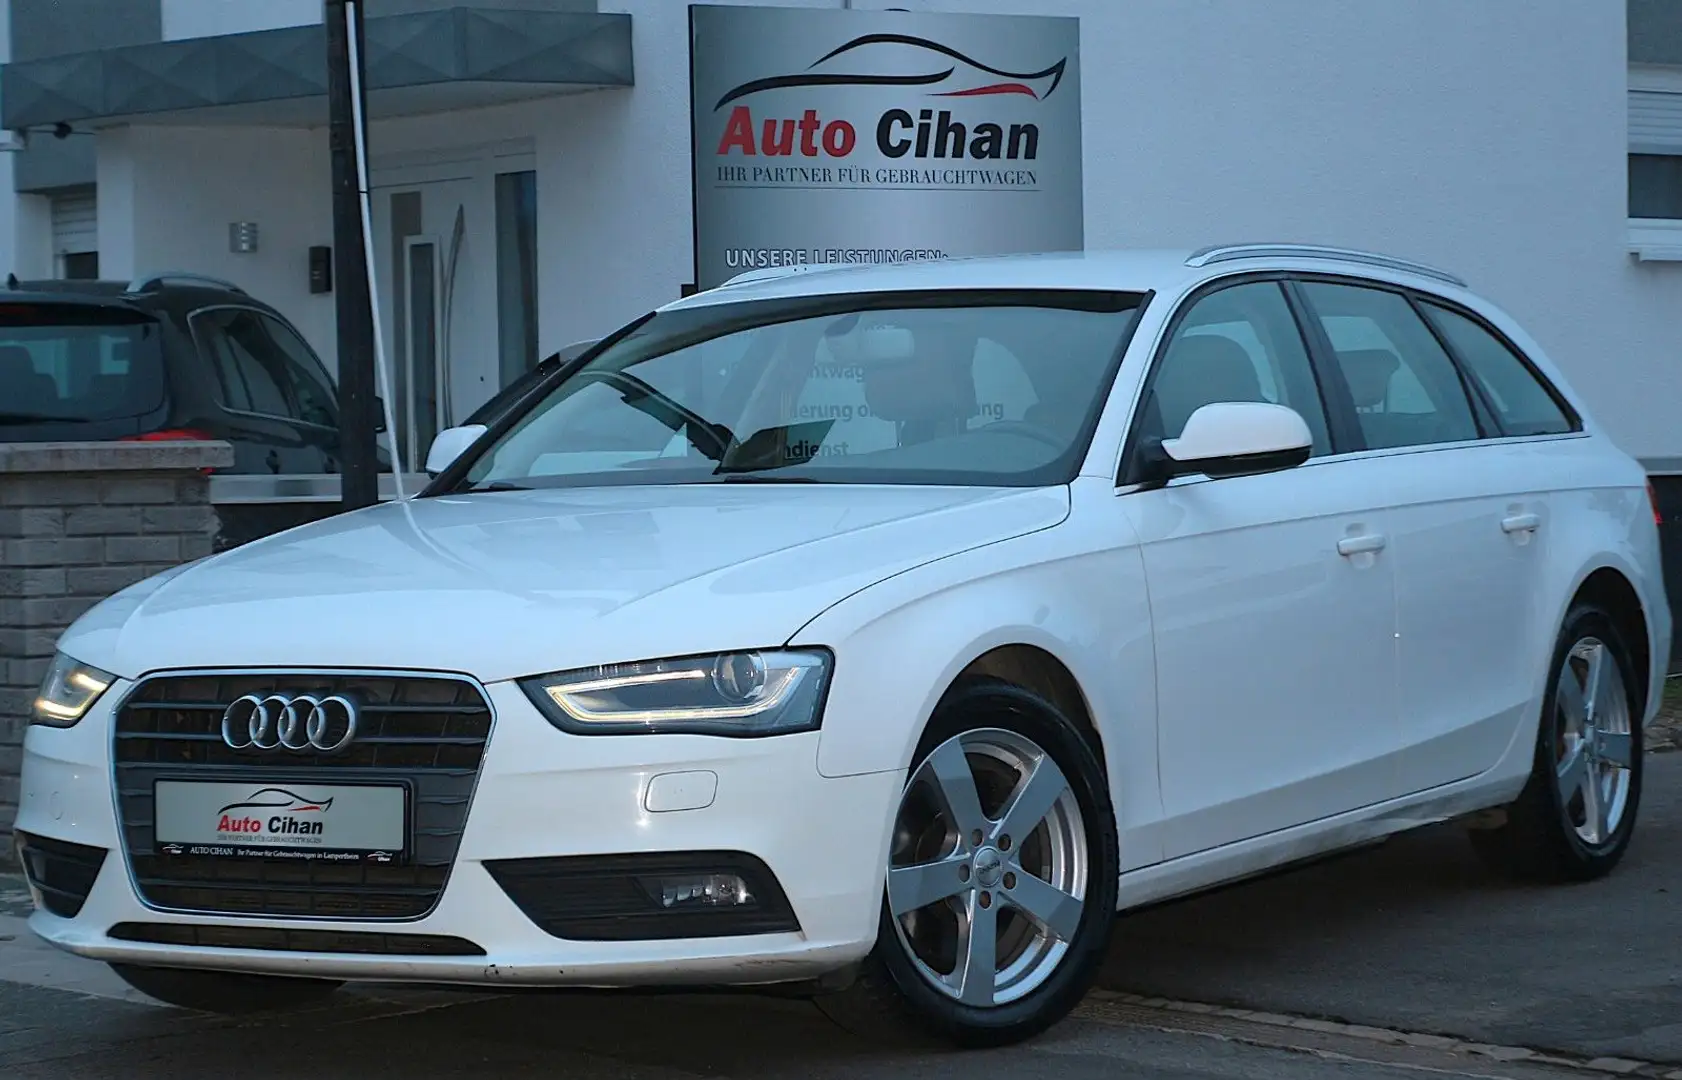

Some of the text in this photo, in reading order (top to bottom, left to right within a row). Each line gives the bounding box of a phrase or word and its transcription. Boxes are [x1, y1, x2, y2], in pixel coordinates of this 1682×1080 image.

[716, 106, 1038, 160] Auto Cihan
[717, 165, 1037, 185] IHR PARTNER FÜR GEBRAUCHTWAGEN
[725, 248, 949, 268] UNSERE LEISTUNGEN
[785, 440, 848, 457] ndienst
[216, 815, 324, 835] Auto Cihan
[190, 846, 210, 854] AUTO
[210, 847, 234, 856] CIHAN
